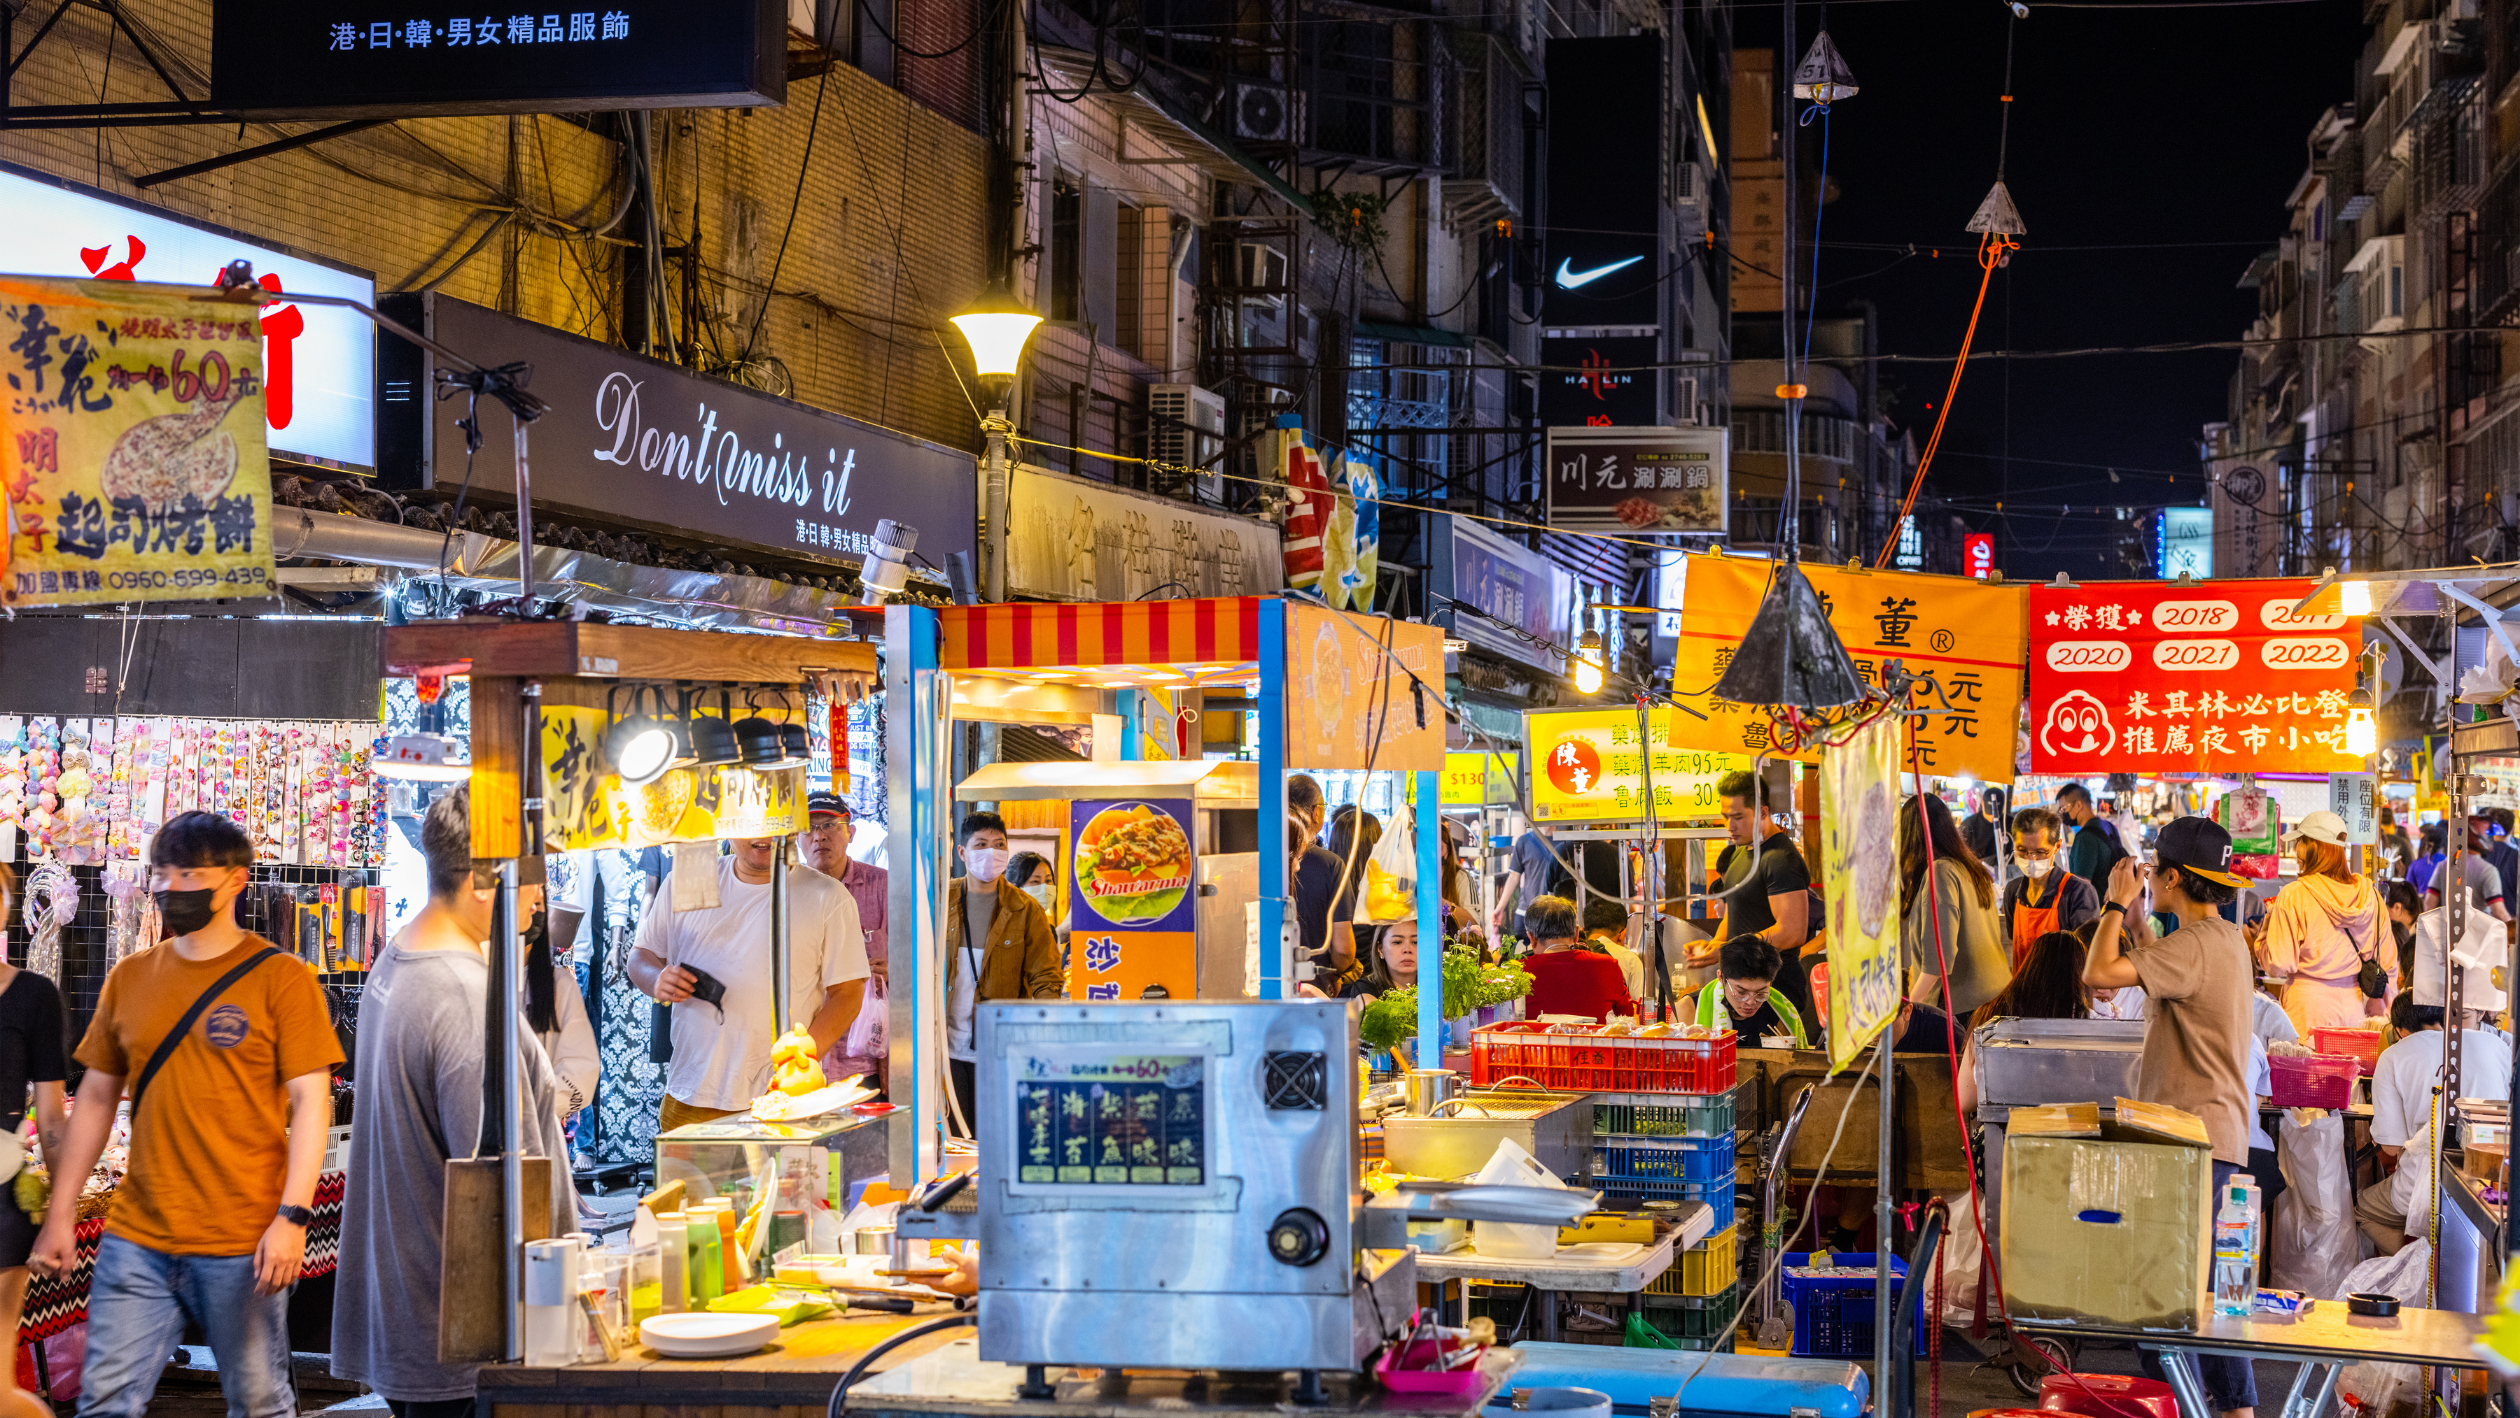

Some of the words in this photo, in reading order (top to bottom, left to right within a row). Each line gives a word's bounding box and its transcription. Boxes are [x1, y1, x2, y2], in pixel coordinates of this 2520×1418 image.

[593, 371, 718, 485] Don't
[715, 430, 813, 506] miss
[822, 447, 856, 516] it
[54, 491, 255, 559] 起司烤餅
[2062, 603, 2127, 632] 榮獲
[2161, 606, 2229, 627] 2018
[2054, 647, 2124, 667] 2020
[2161, 645, 2231, 666] 2021
[2268, 644, 2342, 663] 2022
[2221, 846, 2232, 866] P
[1087, 876, 1188, 899] Shawarma
